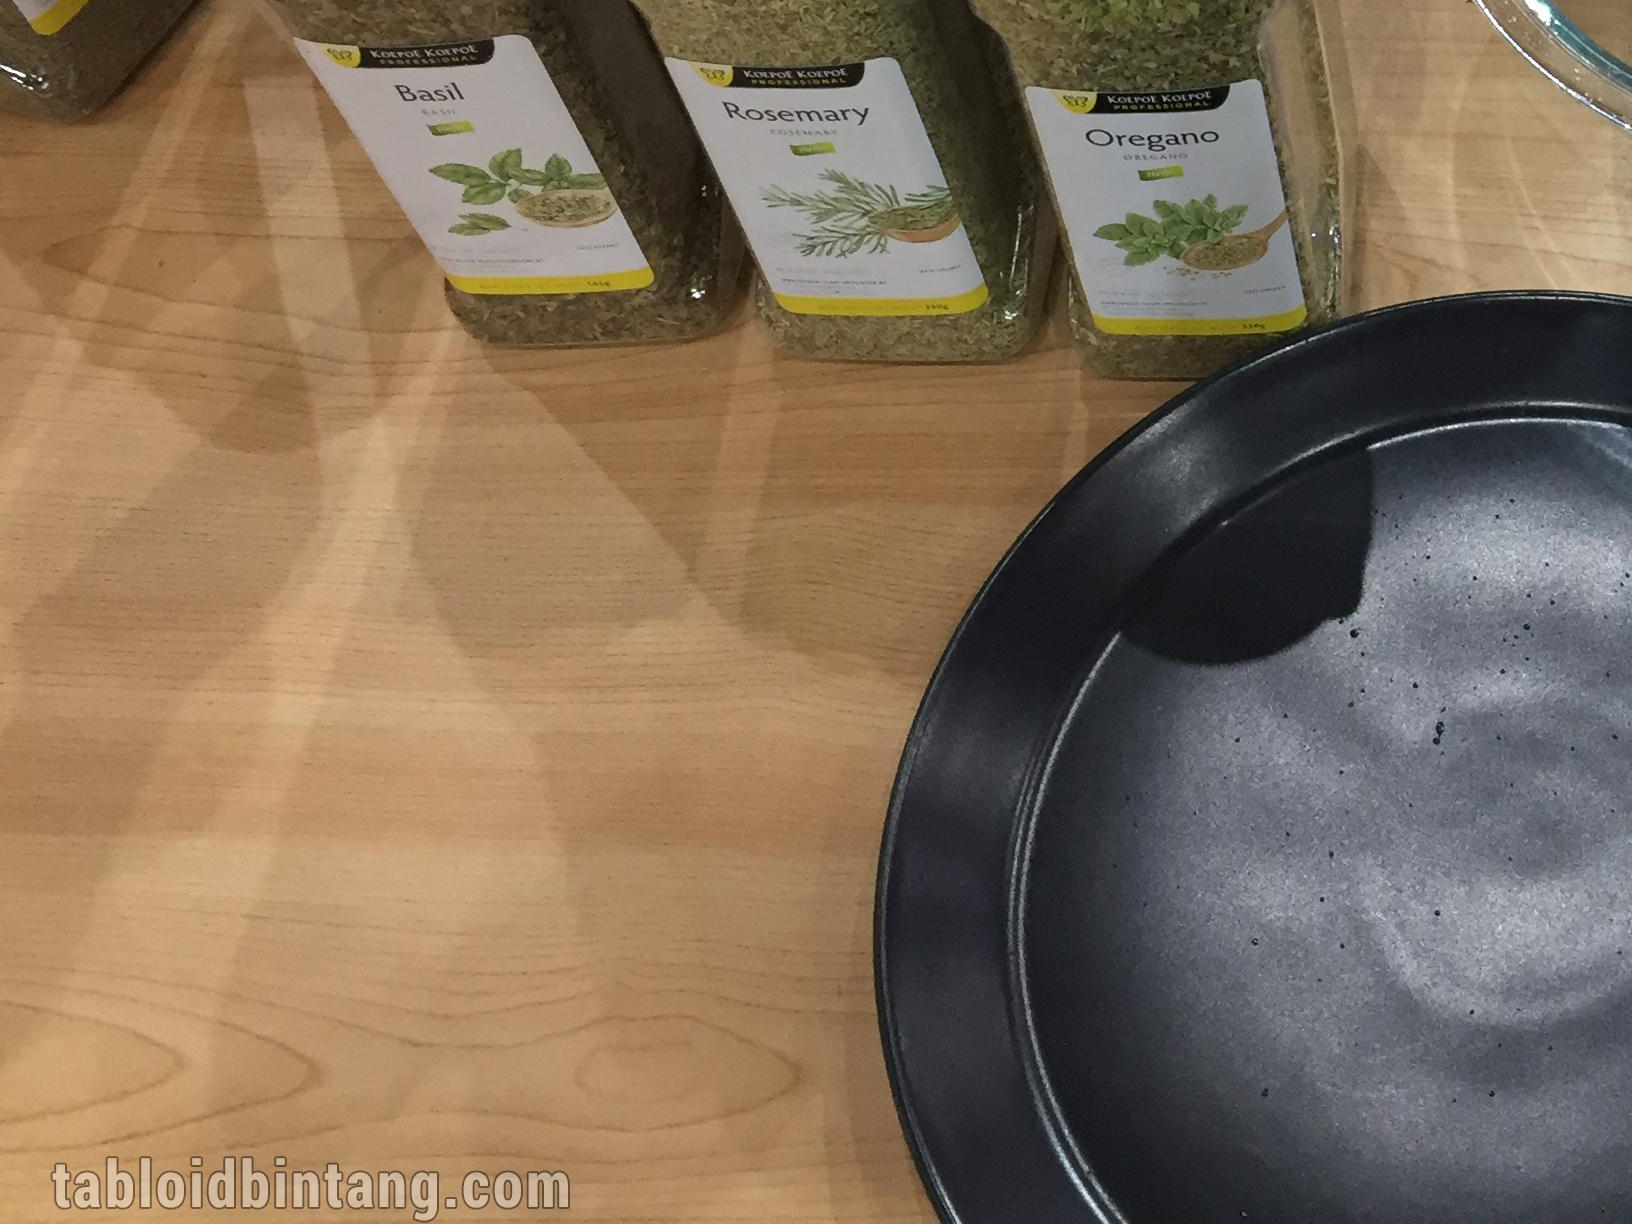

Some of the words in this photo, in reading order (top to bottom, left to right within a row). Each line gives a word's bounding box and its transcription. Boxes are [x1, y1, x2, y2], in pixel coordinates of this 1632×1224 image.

[394, 81, 465, 102] Basil
[722, 101, 870, 126] Rosemary
[1085, 129, 1220, 152] Oregano
